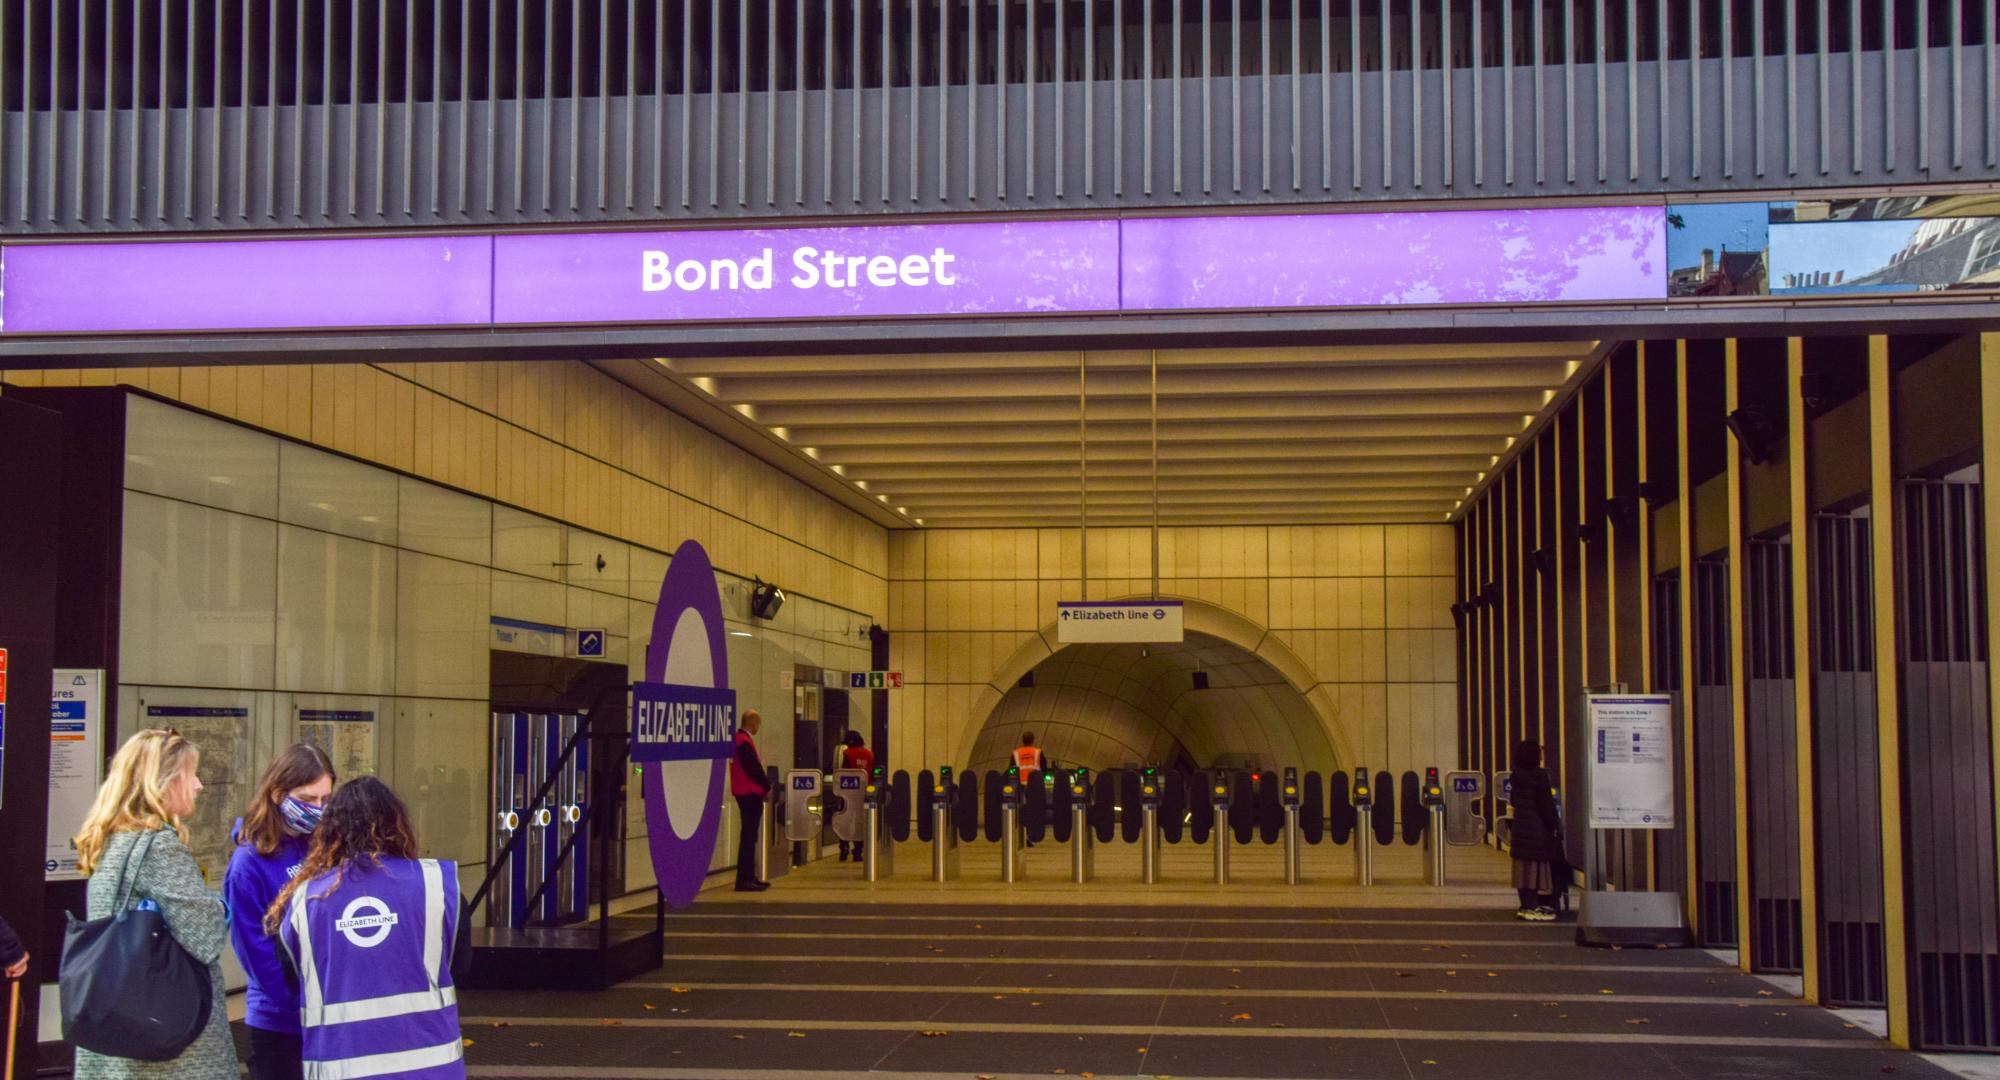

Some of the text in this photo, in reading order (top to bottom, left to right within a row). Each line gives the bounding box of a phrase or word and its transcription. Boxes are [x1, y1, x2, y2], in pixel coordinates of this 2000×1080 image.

[642, 246, 956, 292] Bond Street
[1072, 609, 1149, 620] Elizabeth line
[52, 690, 75, 698] ures
[638, 700, 732, 743] ELIZABETH LINE
[339, 915, 395, 928] ELIZABETH LINE
